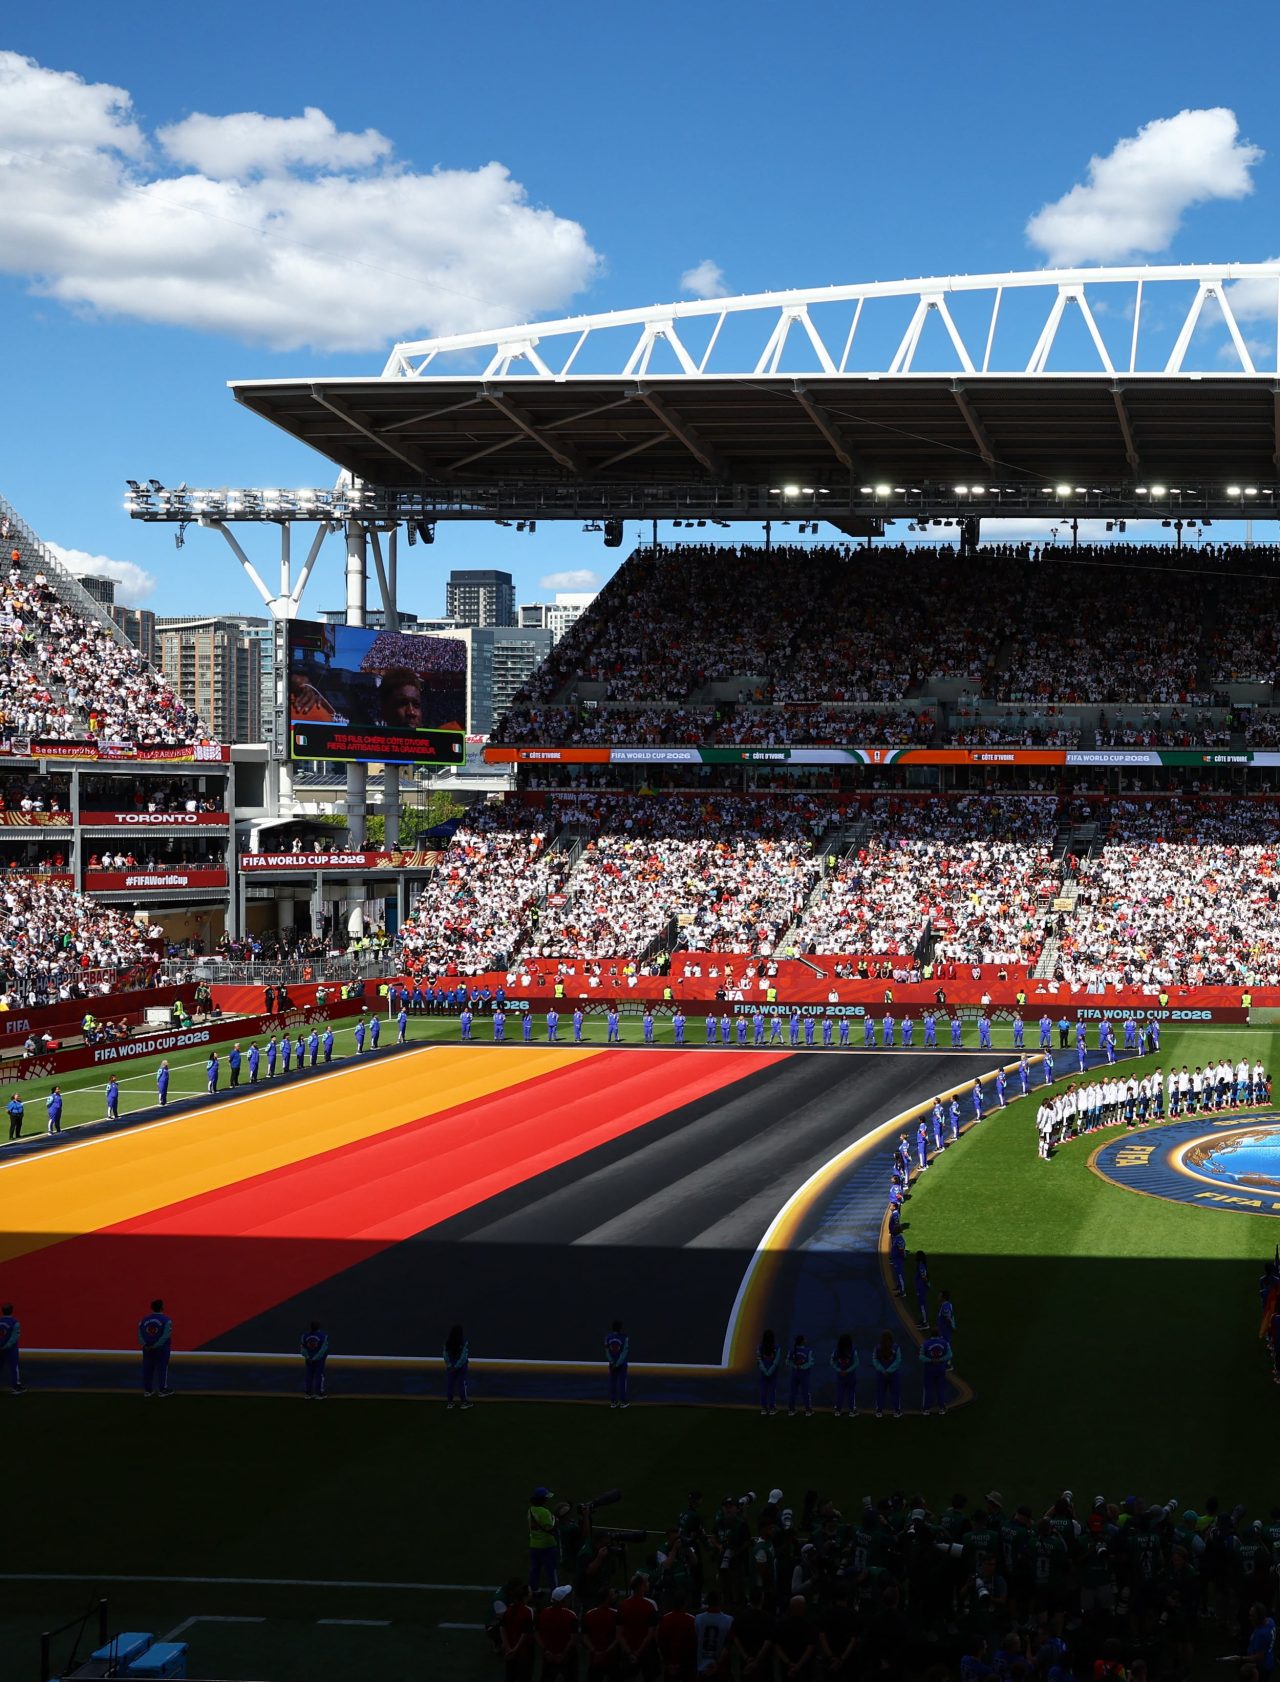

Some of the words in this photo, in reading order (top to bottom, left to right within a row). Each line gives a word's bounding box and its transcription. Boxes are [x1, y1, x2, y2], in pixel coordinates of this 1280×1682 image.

[115, 814, 198, 823] TORONTO
[242, 856, 267, 866] FIFA
[267, 856, 306, 865] WORLD
[308, 855, 328, 865] CUP
[330, 855, 365, 864] 2026
[125, 875, 188, 887] #FIFAWorldCup
[734, 1004, 756, 1014] FIFA
[801, 1005, 823, 1015] CUP
[826, 1006, 865, 1016] 2026
[1077, 1009, 1101, 1018] FIFA
[1102, 1009, 1145, 1019] WORLD
[1147, 1010, 1170, 1019] CUP
[1171, 1010, 1212, 1020] 2026
[6, 1019, 30, 1033] FIFA
[94, 1047, 118, 1061] FIFA
[119, 1041, 155, 1057] WORLD
[156, 1037, 176, 1050] CUP
[177, 1031, 210, 1046] 2026
[1115, 1145, 1156, 1167] FIFA
[1193, 1191, 1262, 1207] FIFA
